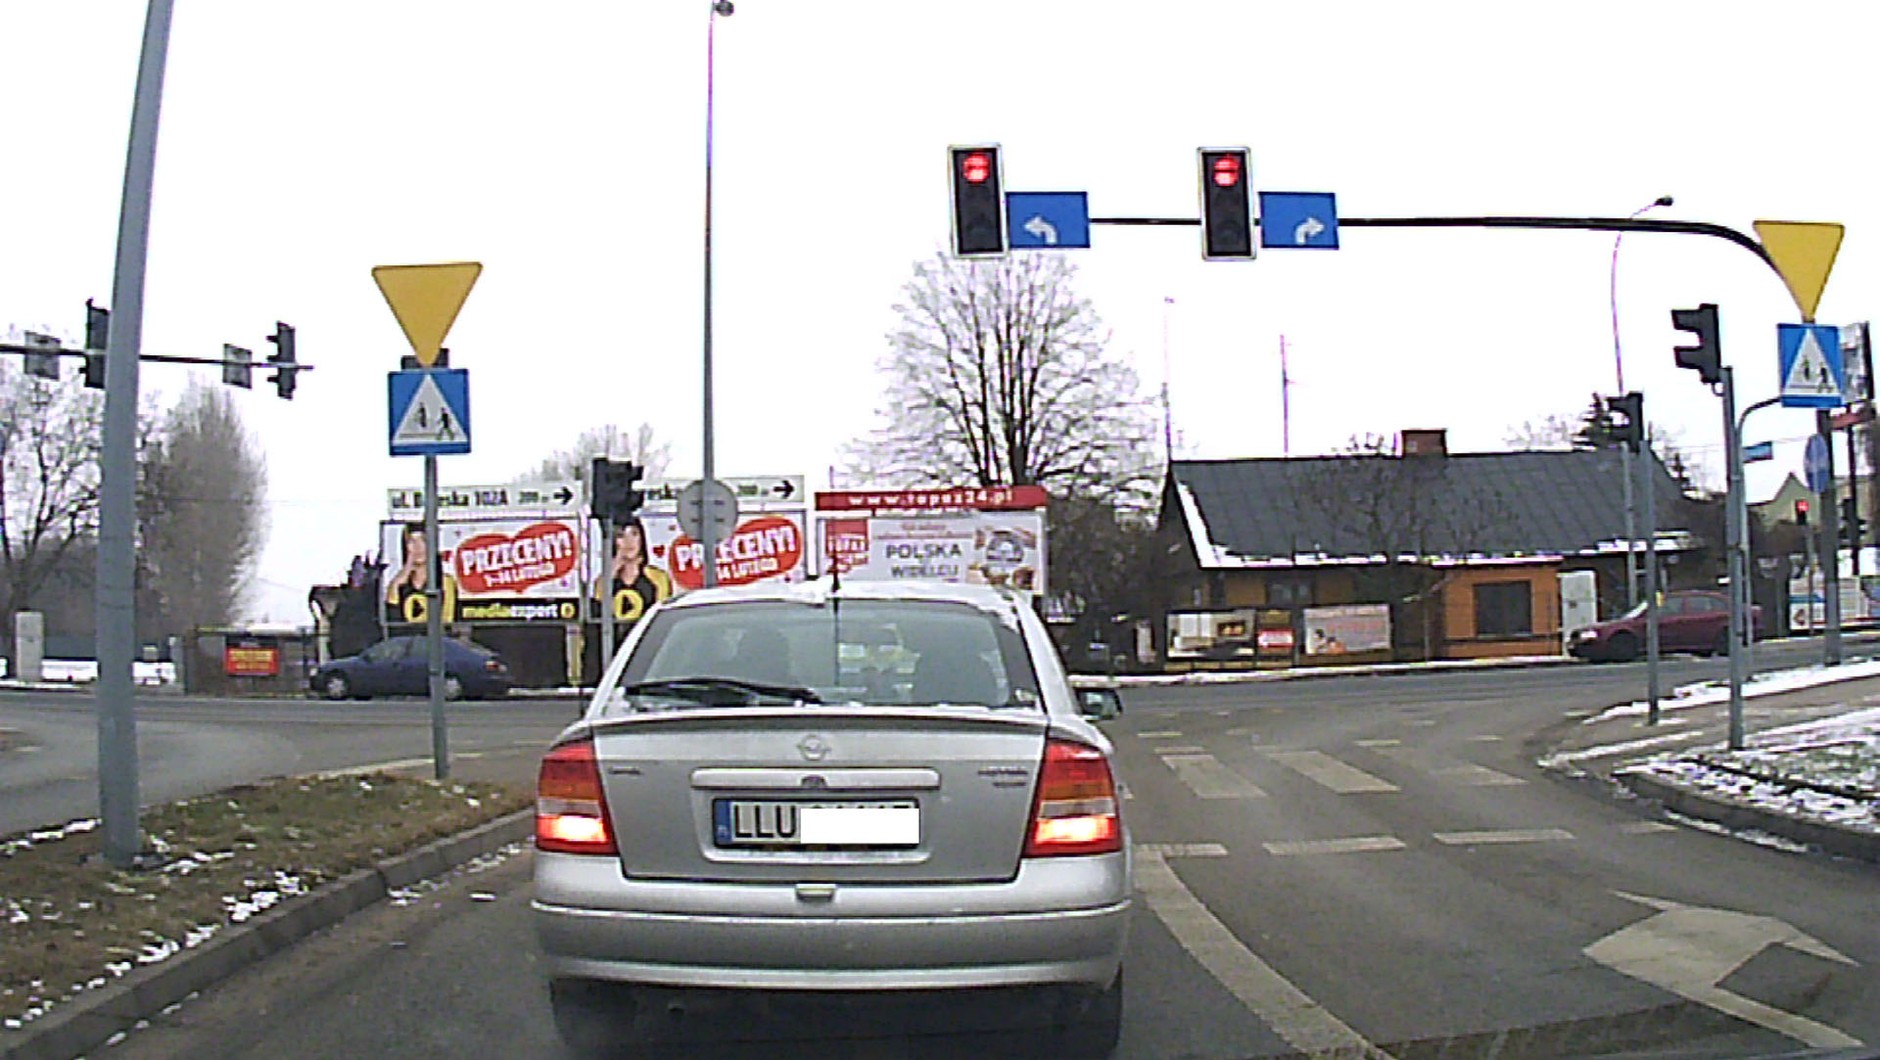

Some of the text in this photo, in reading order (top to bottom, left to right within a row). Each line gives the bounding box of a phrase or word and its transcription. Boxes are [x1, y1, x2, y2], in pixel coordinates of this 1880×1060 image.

[413, 490, 469, 507] Beska
[461, 530, 572, 575] PRZECENY!
[676, 526, 796, 571] PRECENY!
[885, 543, 962, 559] POLSKA
[462, 602, 559, 622] mediaexpert
[735, 804, 796, 838] LLU
